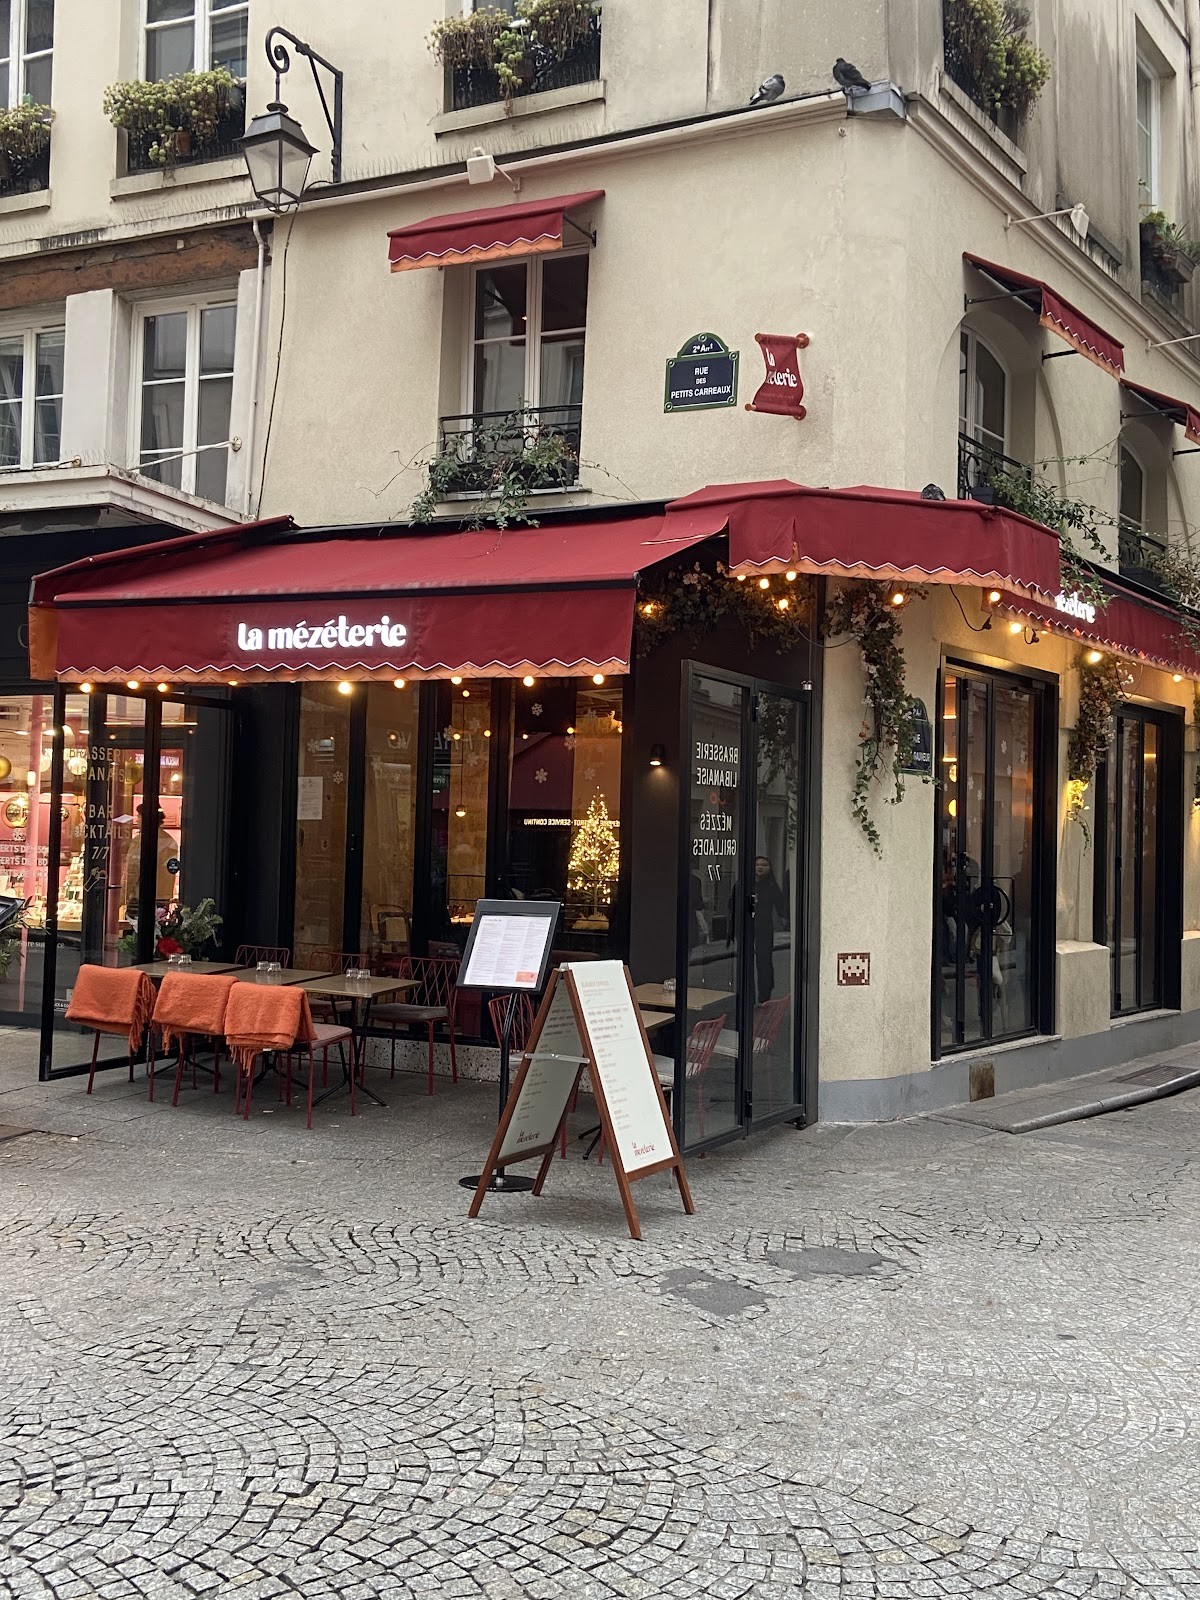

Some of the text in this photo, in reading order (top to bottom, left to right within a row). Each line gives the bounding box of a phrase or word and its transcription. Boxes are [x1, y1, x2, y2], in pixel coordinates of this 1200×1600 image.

[694, 366, 709, 376] RUE
[695, 377, 707, 385] DES
[670, 384, 731, 400] PETITS CARREAUX
[237, 614, 407, 651] la mézéterie
[88, 803, 113, 819] BAR
[91, 846, 109, 860] 7/7
